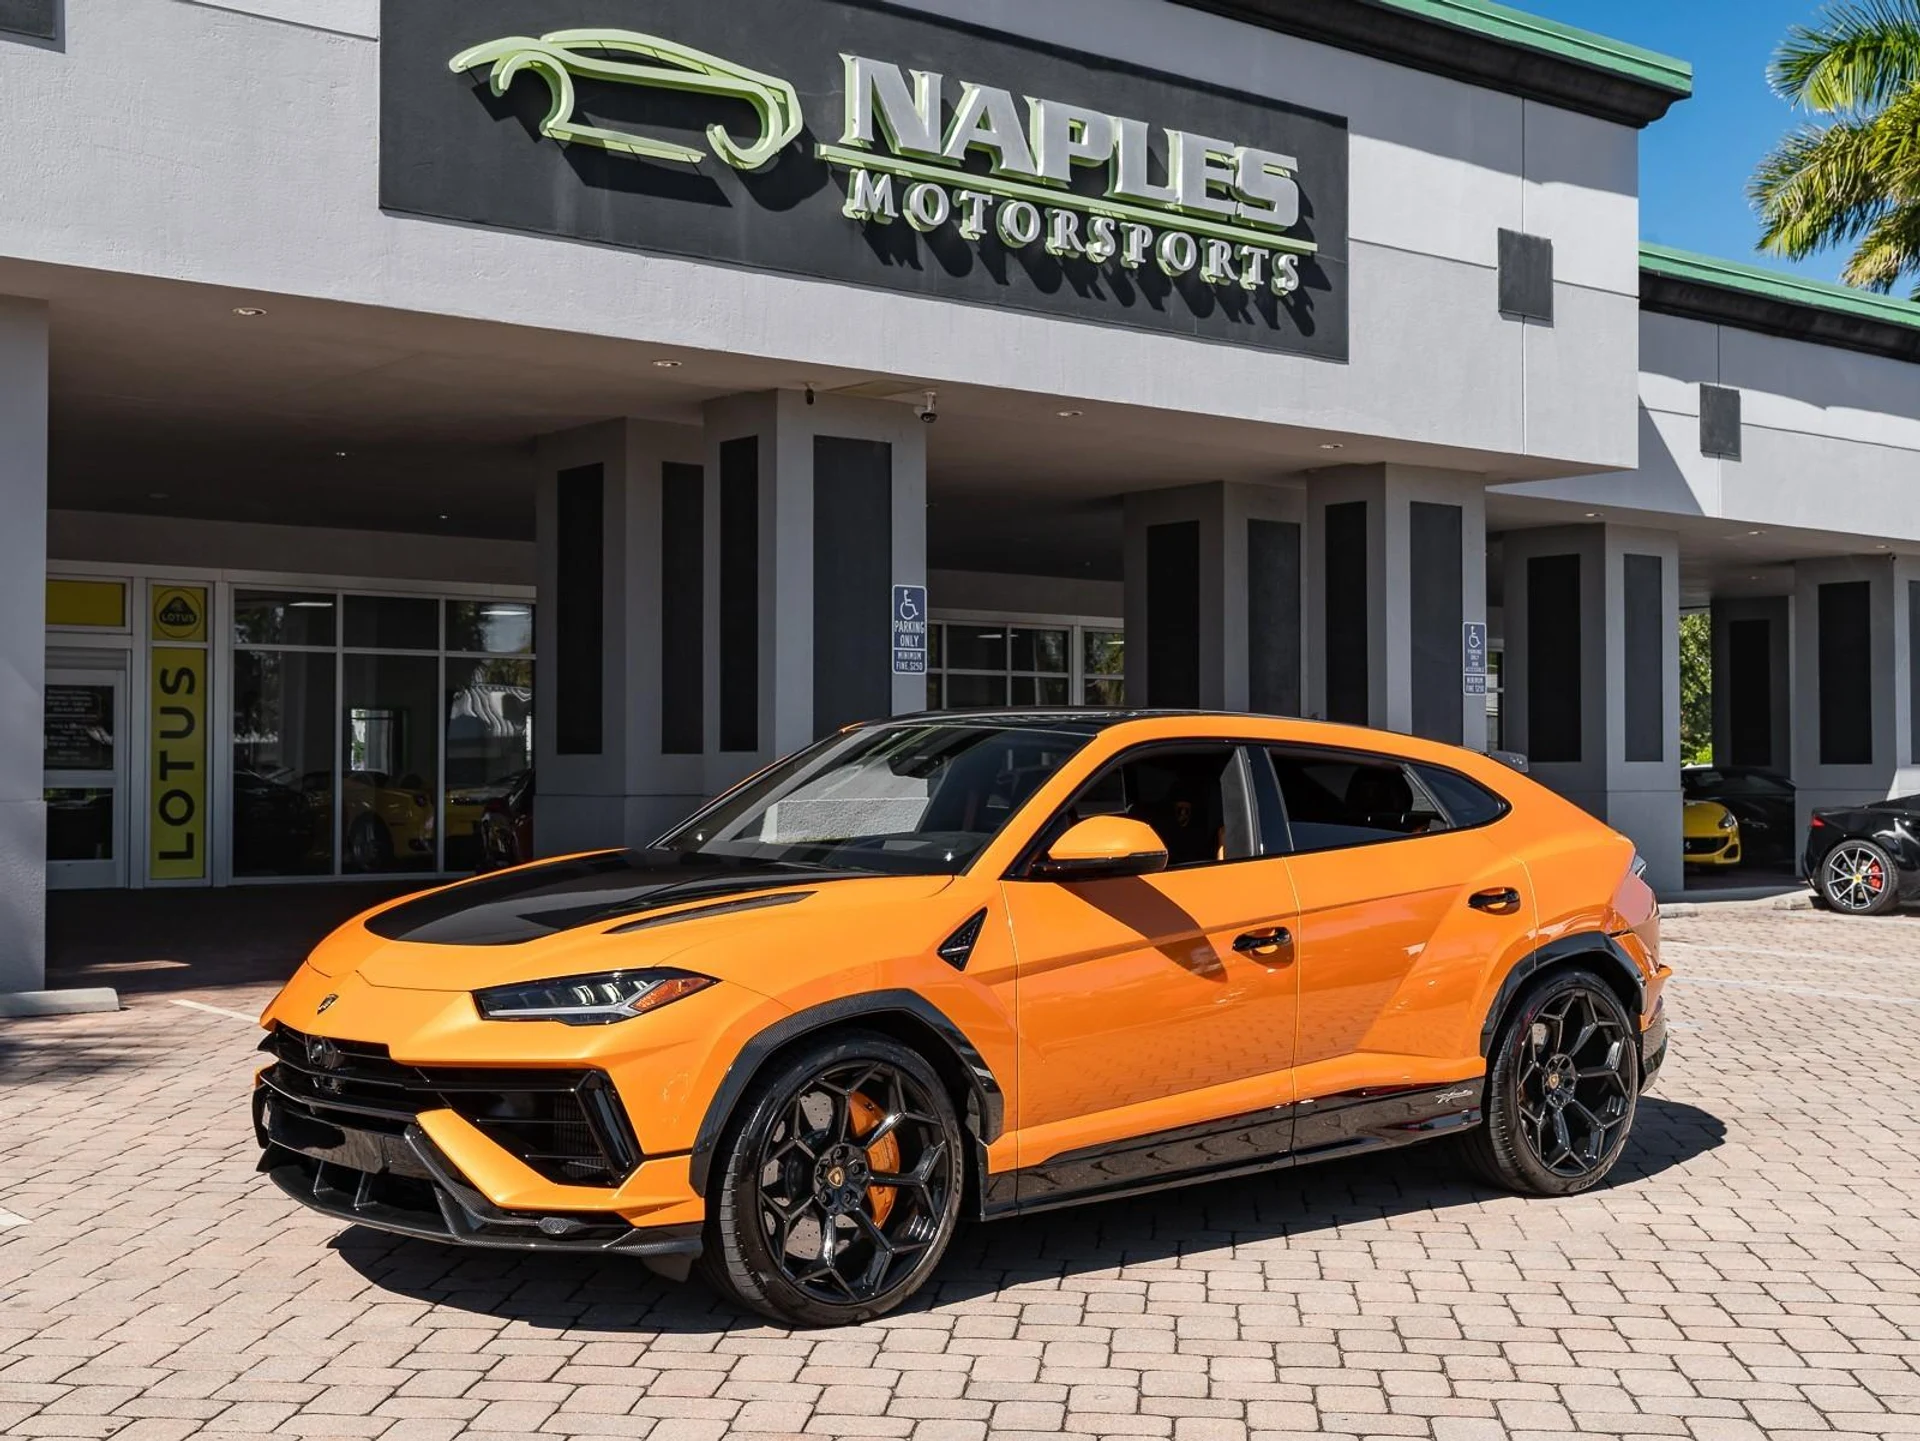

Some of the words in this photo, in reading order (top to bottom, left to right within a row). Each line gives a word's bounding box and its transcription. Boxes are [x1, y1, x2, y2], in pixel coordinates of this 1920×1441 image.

[839, 53, 1299, 227] NAPLES
[843, 168, 1299, 296] MOTORSPORTS
[161, 612, 195, 623] LOTUS
[895, 620, 924, 633] PARKING
[900, 634, 919, 647] ONLY
[897, 651, 922, 660] MINIMUM
[896, 661, 908, 670] FINE
[159, 667, 195, 860] LOTUS
